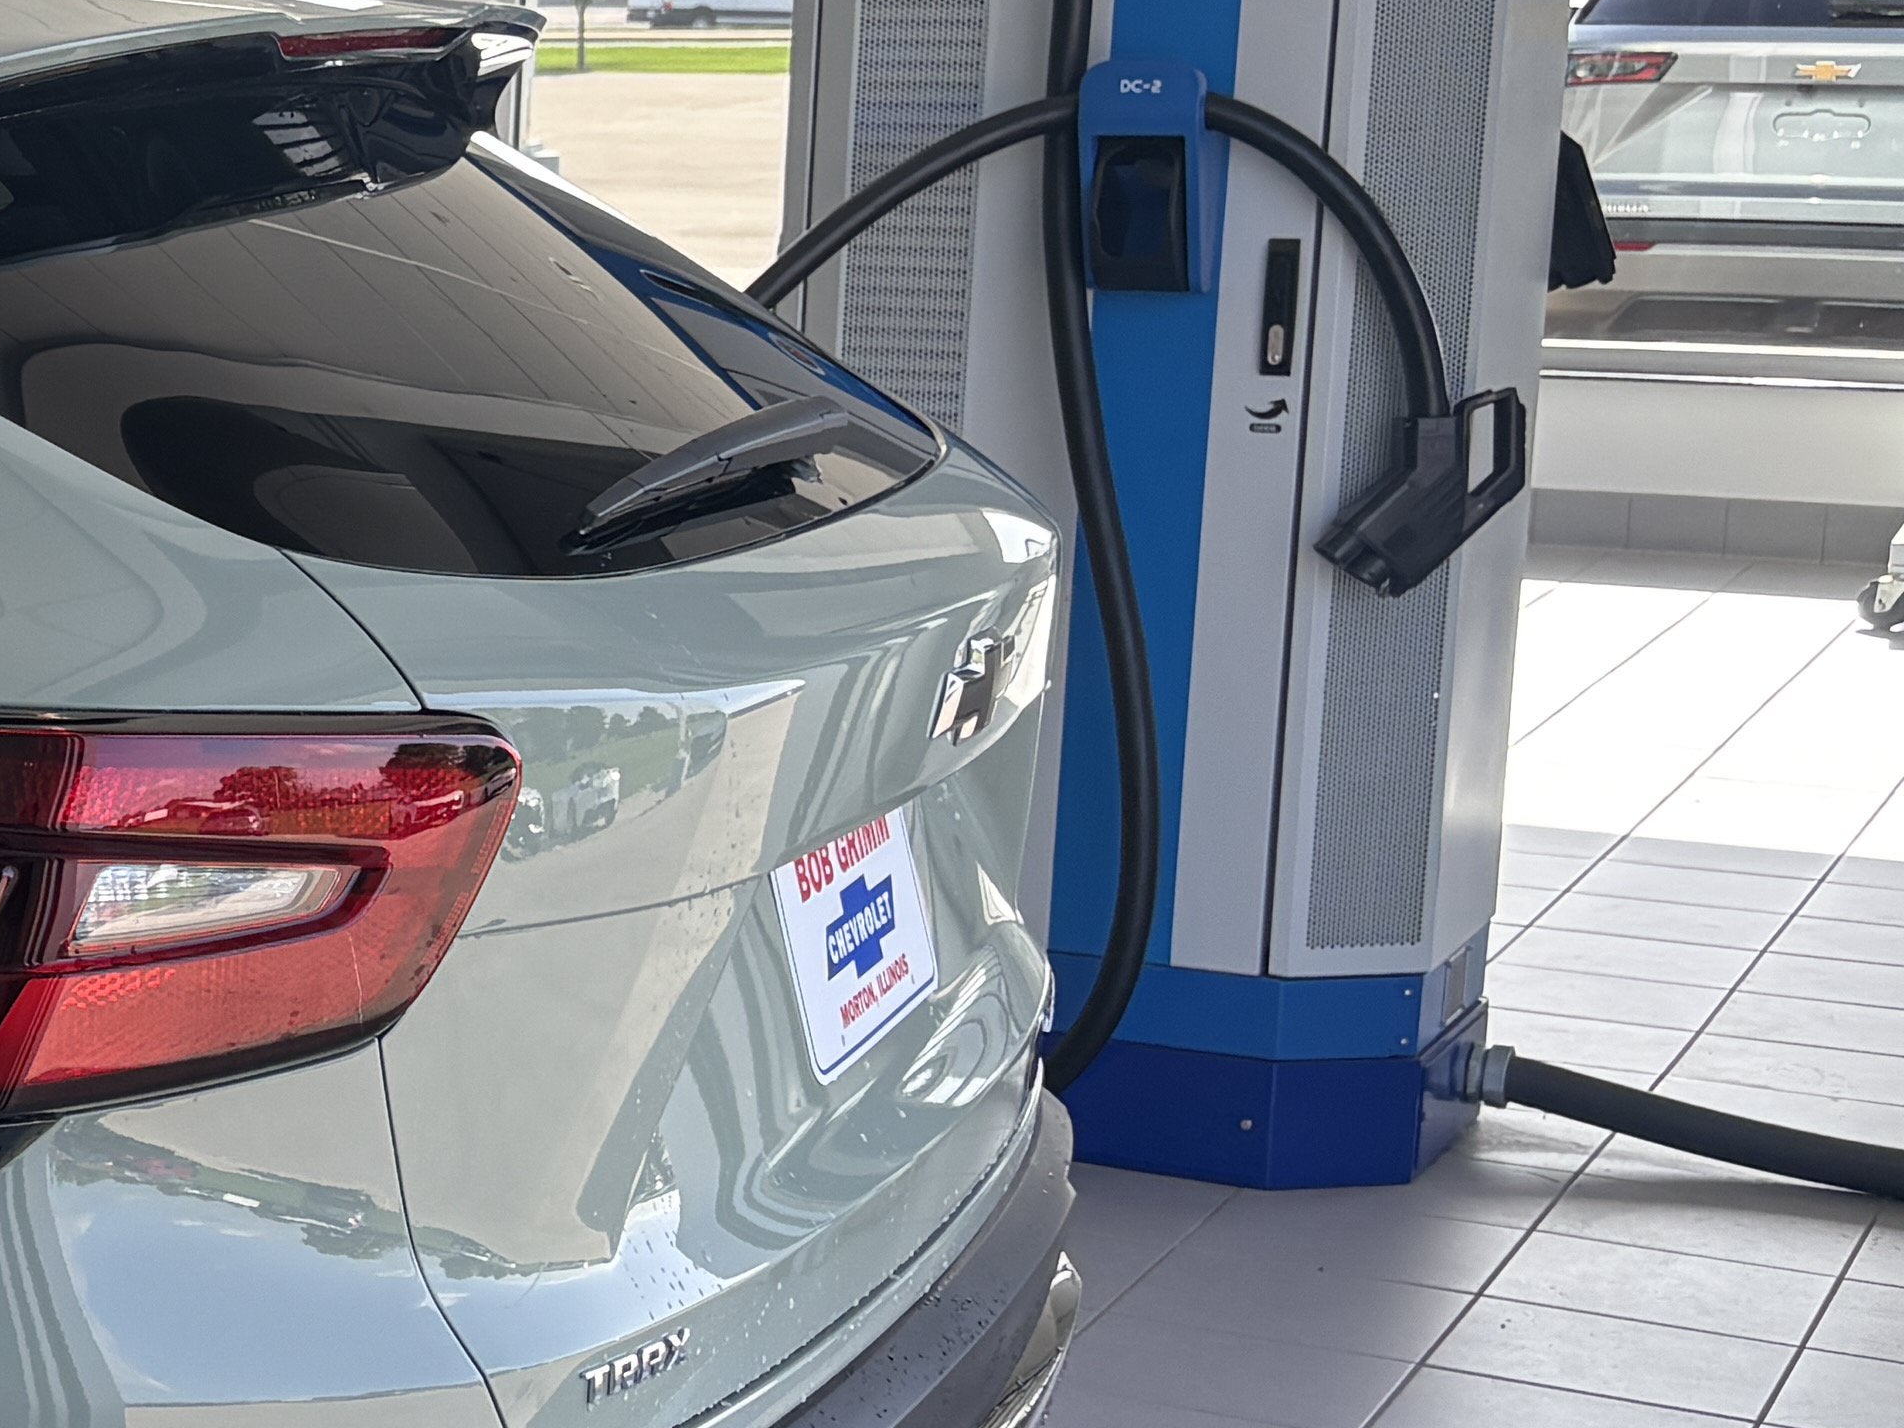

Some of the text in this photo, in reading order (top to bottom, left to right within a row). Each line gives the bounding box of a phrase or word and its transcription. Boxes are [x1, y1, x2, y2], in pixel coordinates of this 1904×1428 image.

[1120, 79, 1162, 94] DC-2
[794, 815, 890, 903] BOB GRIMM
[828, 891, 892, 964] CHEVROLET
[840, 953, 909, 1029] MORTON, ILLINOIS
